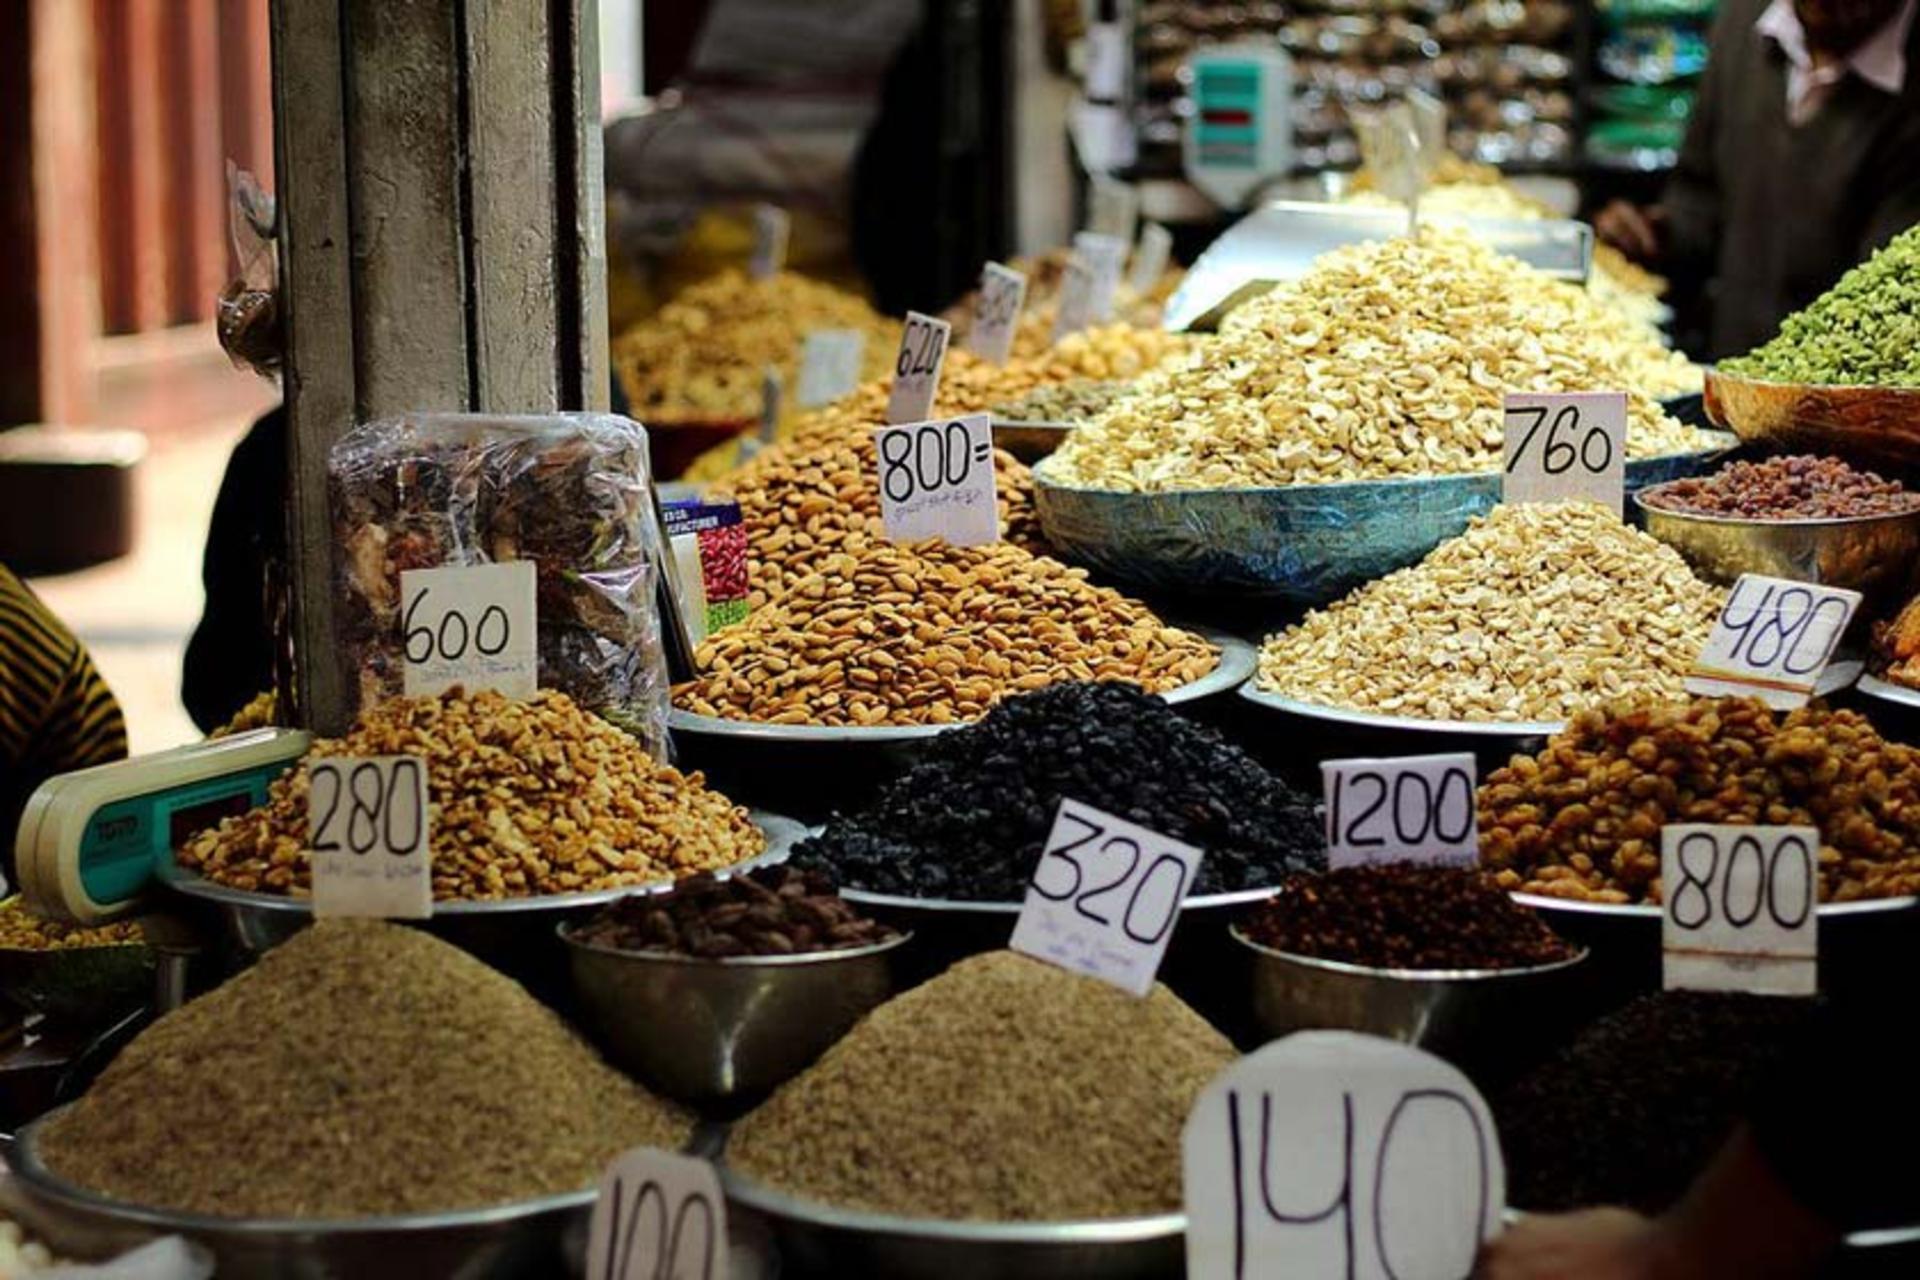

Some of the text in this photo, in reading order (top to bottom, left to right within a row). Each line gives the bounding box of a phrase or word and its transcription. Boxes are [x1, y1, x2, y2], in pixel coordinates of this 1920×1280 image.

[897, 321, 944, 377] 620
[1505, 405, 1612, 474] 760
[404, 587, 509, 664] 600
[1721, 579, 1849, 675] 480
[311, 759, 422, 856] 280
[1331, 767, 1474, 846] 1200
[1029, 811, 1187, 944] 320
[1670, 832, 1812, 930] 800
[1228, 1088, 1489, 1280] 140
